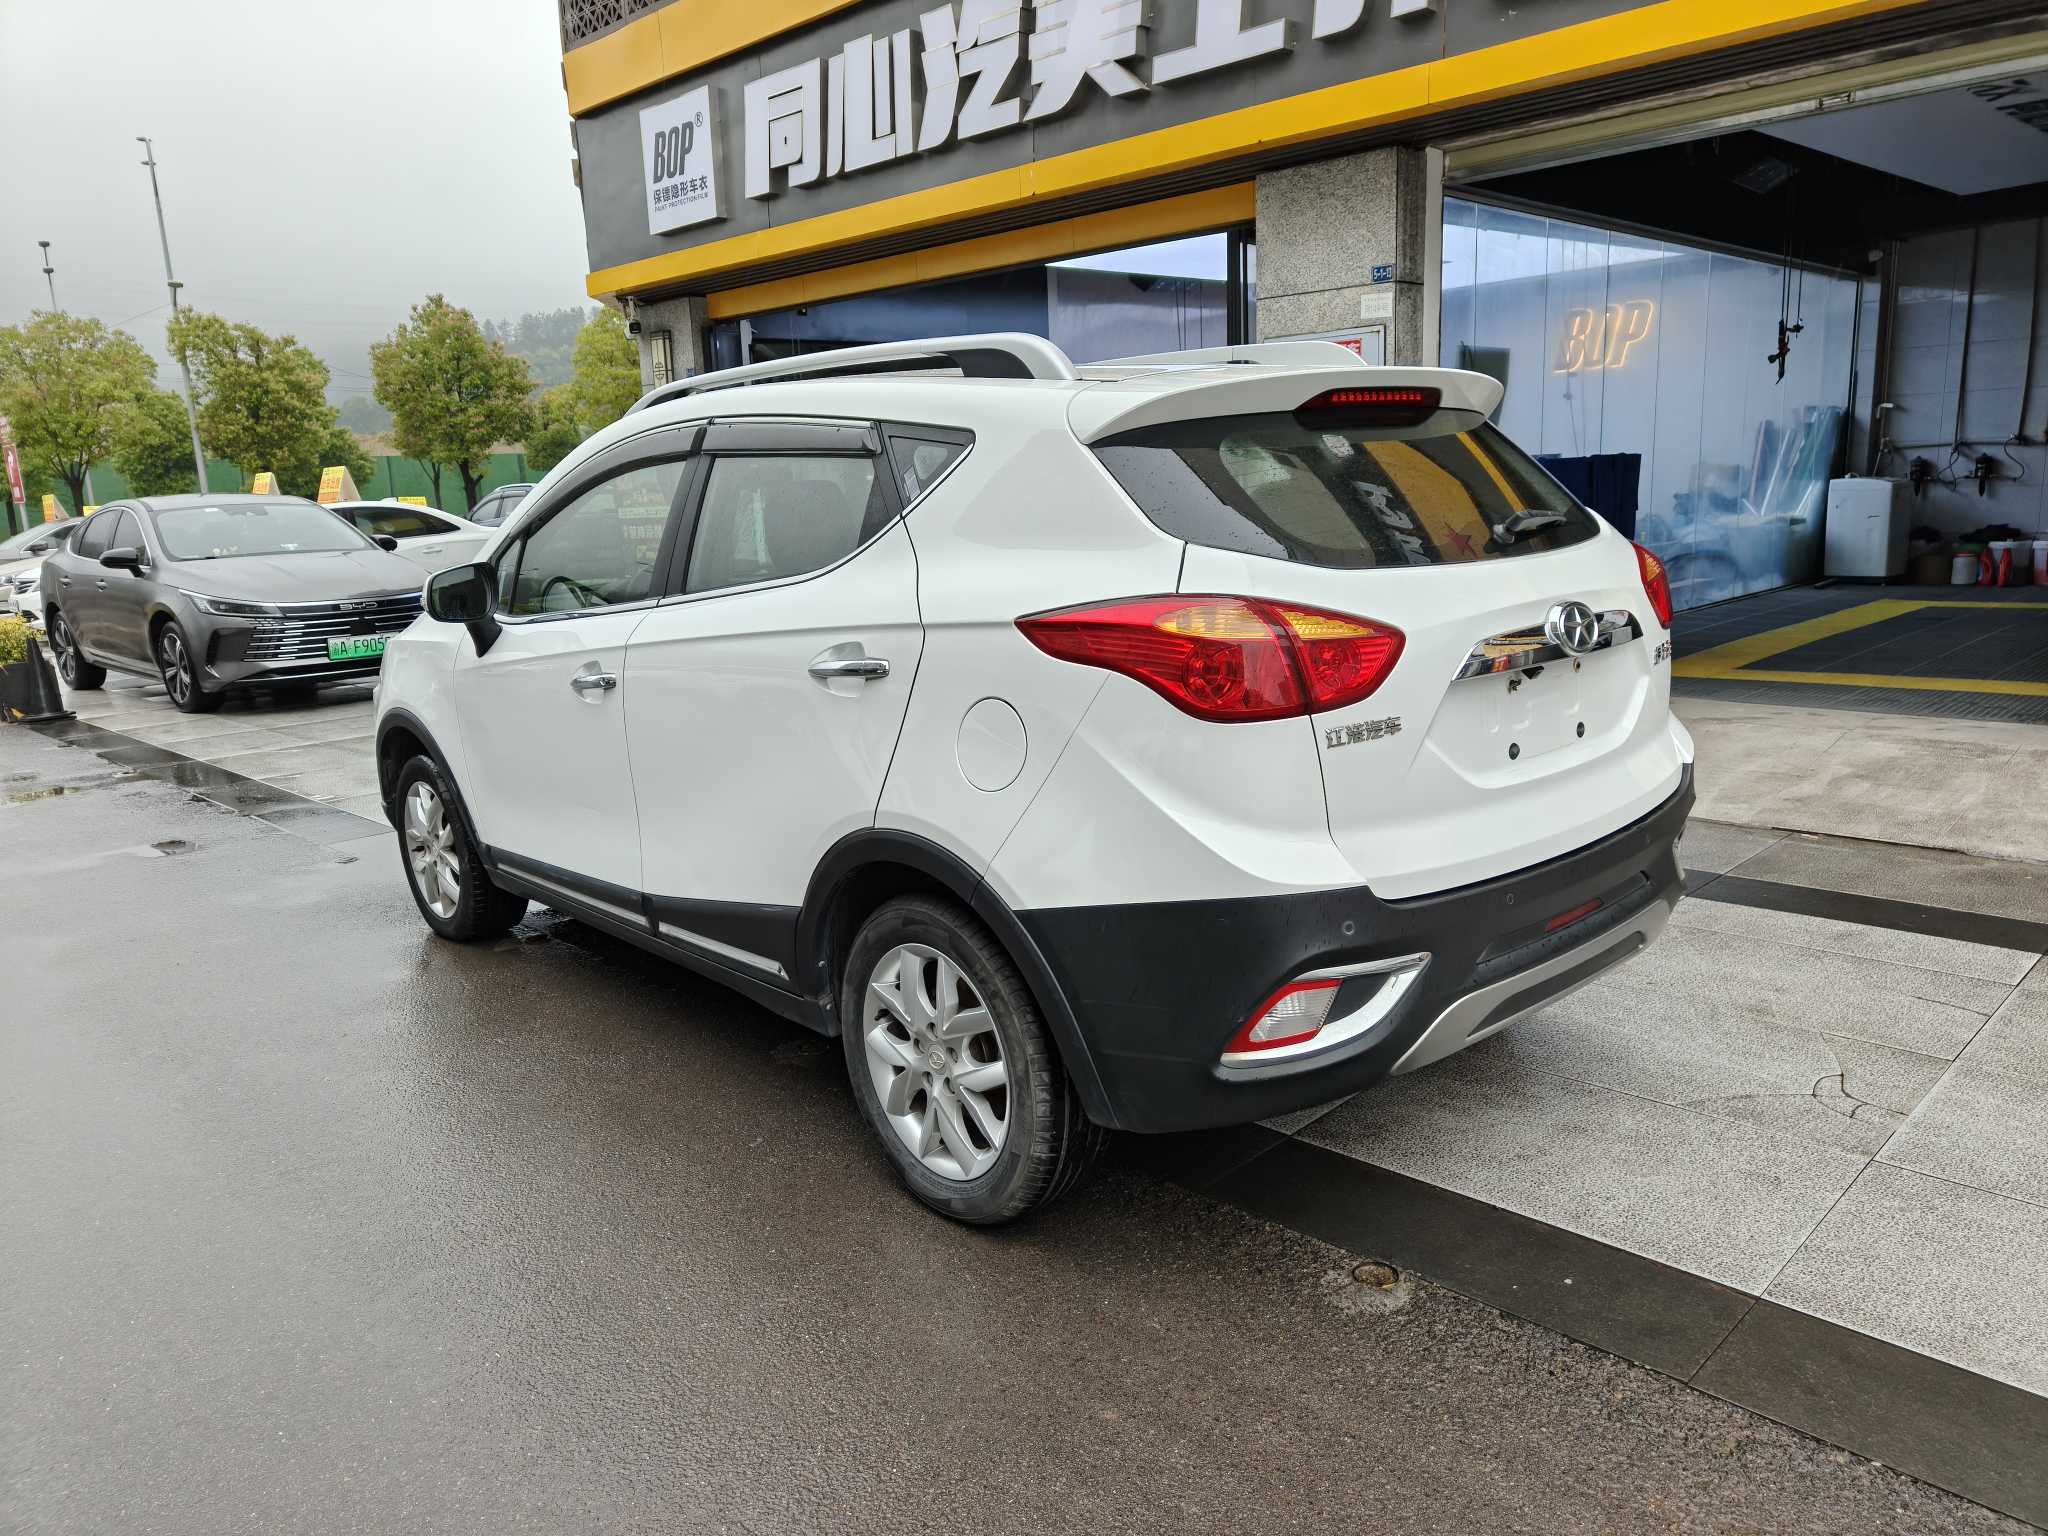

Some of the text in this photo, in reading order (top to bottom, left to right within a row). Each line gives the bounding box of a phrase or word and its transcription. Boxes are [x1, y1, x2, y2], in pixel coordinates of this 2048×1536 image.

[744, 0, 1432, 200] 同心汽美
[653, 175, 708, 205] 保镖隐形车衣
[1553, 299, 1654, 374] BOP
[340, 601, 378, 611] BYD
[1325, 716, 1402, 749] 江淮汽车
